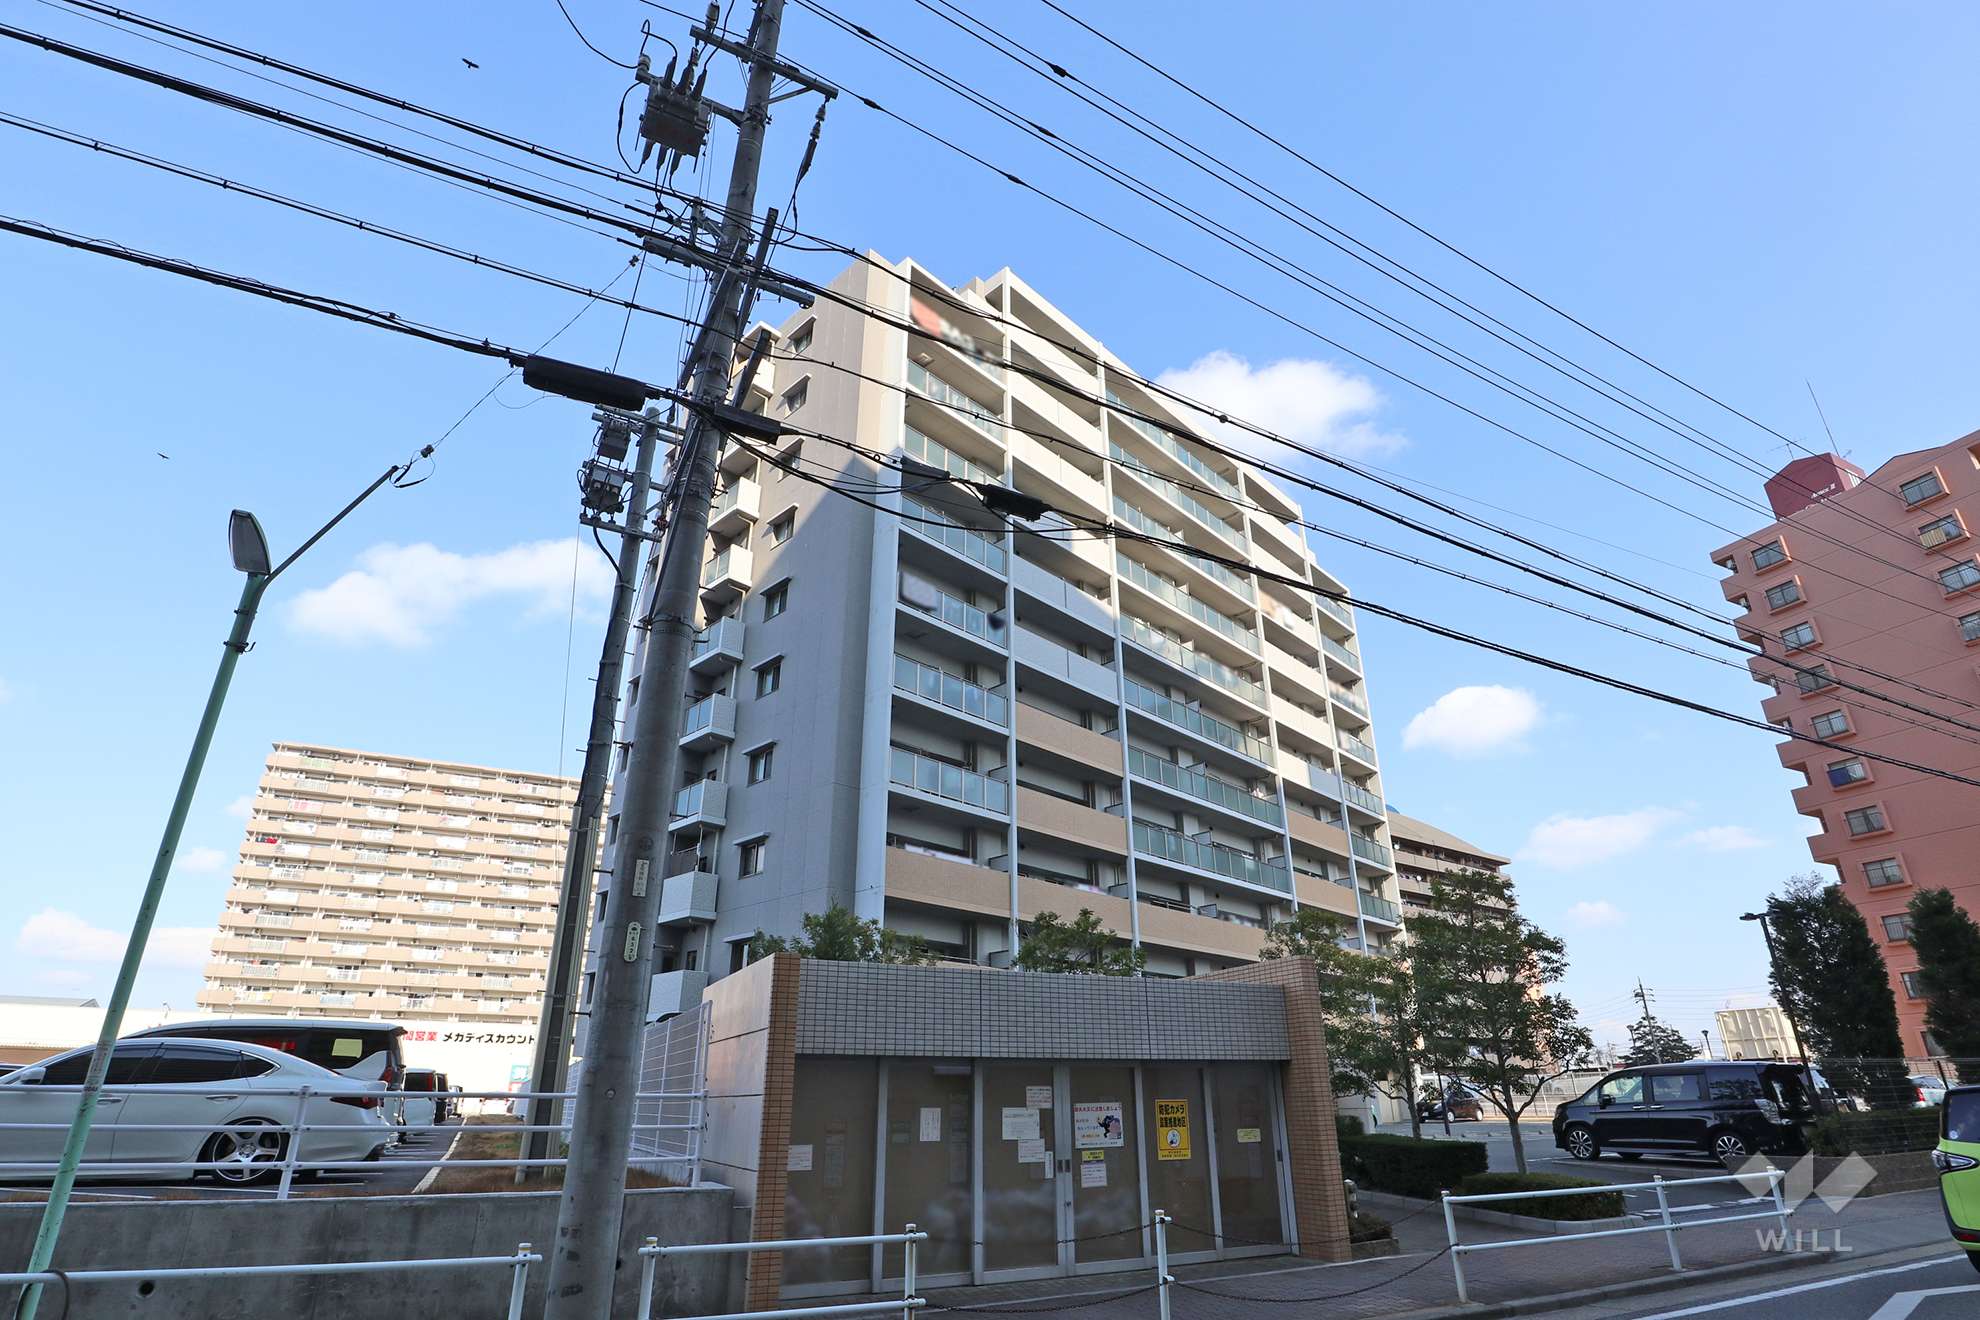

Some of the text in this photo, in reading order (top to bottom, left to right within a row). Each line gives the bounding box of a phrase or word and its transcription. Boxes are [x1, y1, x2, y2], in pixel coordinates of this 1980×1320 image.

[1159, 1104, 1185, 1115] 防犯カメラ
